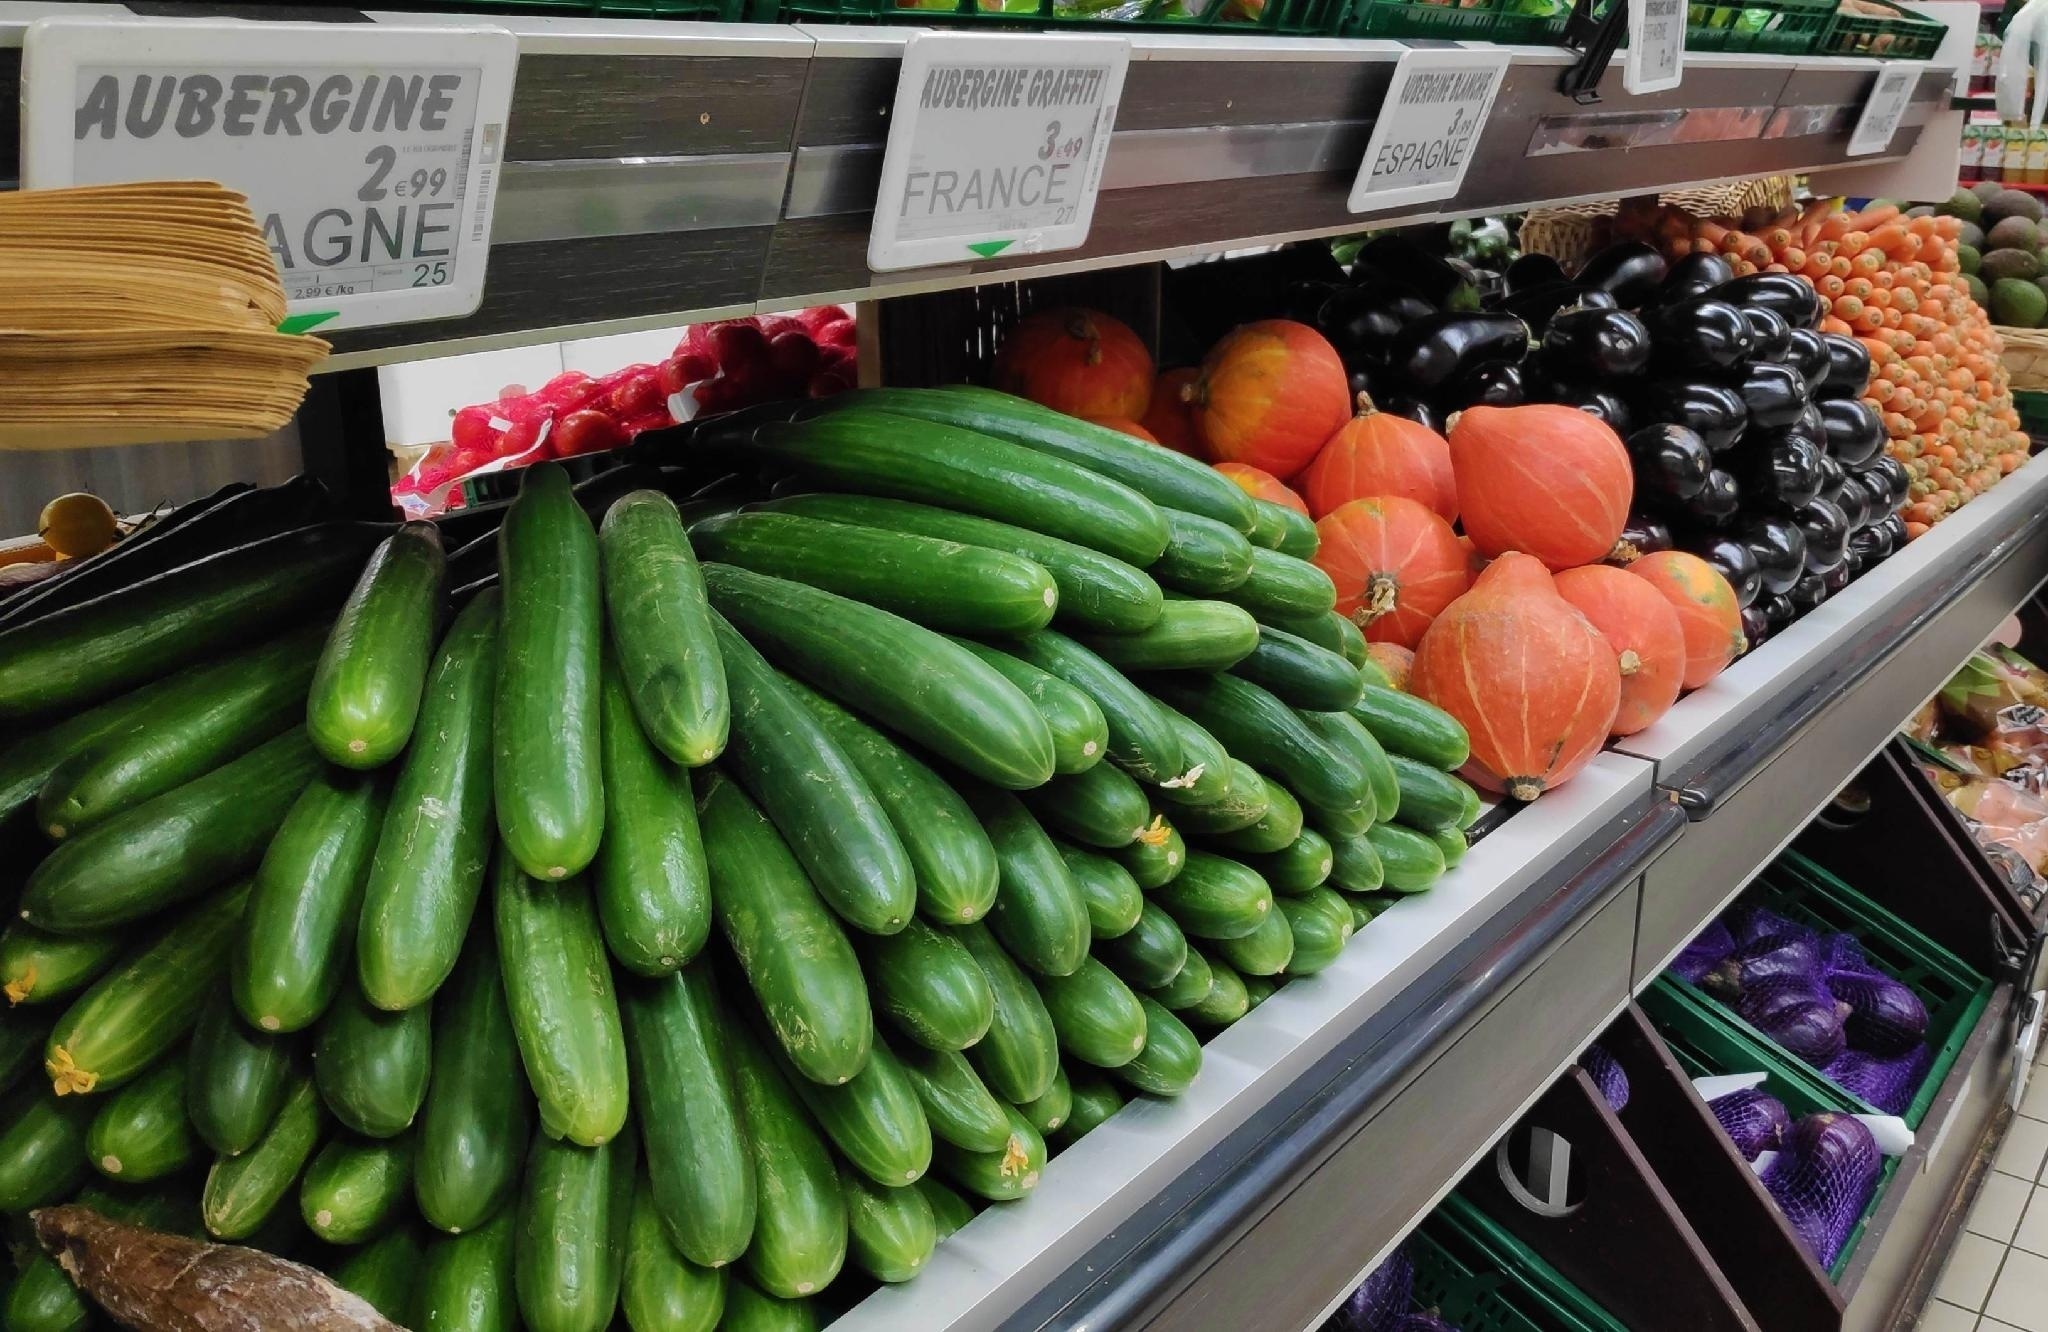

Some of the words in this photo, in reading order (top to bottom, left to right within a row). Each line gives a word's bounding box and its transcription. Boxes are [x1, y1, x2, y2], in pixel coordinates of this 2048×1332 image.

[75, 74, 461, 140] AUBERGINE
[919, 69, 1028, 111] AUBERGINE
[1027, 69, 1104, 110] GRAFFITI
[1372, 138, 1468, 176] ESPAGNE
[900, 163, 1071, 217] FRANCE
[1054, 205, 1074, 227] 27
[412, 262, 448, 288] 25
